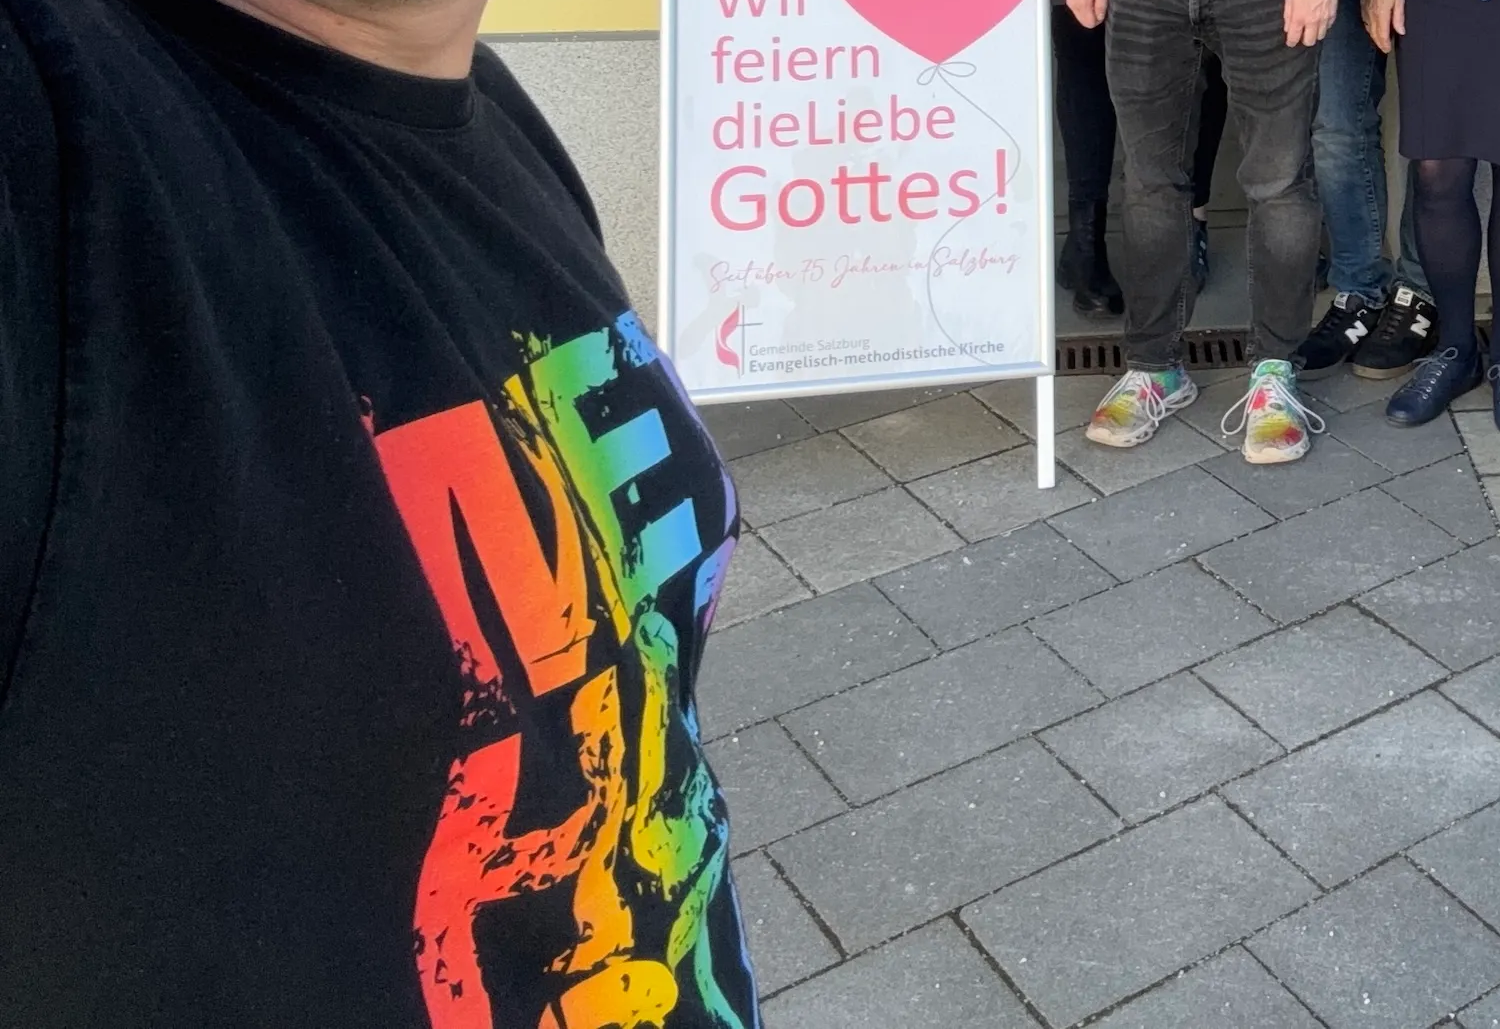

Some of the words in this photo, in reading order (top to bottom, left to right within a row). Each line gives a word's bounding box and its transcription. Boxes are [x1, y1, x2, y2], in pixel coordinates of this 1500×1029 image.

[711, 35, 879, 84] feiern
[710, 148, 1007, 232] Gottes!
[710, 260, 760, 293] Seit
[801, 258, 826, 283] 75
[831, 255, 904, 288] Jahren
[932, 246, 1020, 277] Salzburg
[749, 341, 814, 357] Gemeinde
[817, 337, 871, 352] Salzburg
[749, 344, 956, 373] Evangelisch-methodistische
[959, 339, 1005, 356] Kirche
